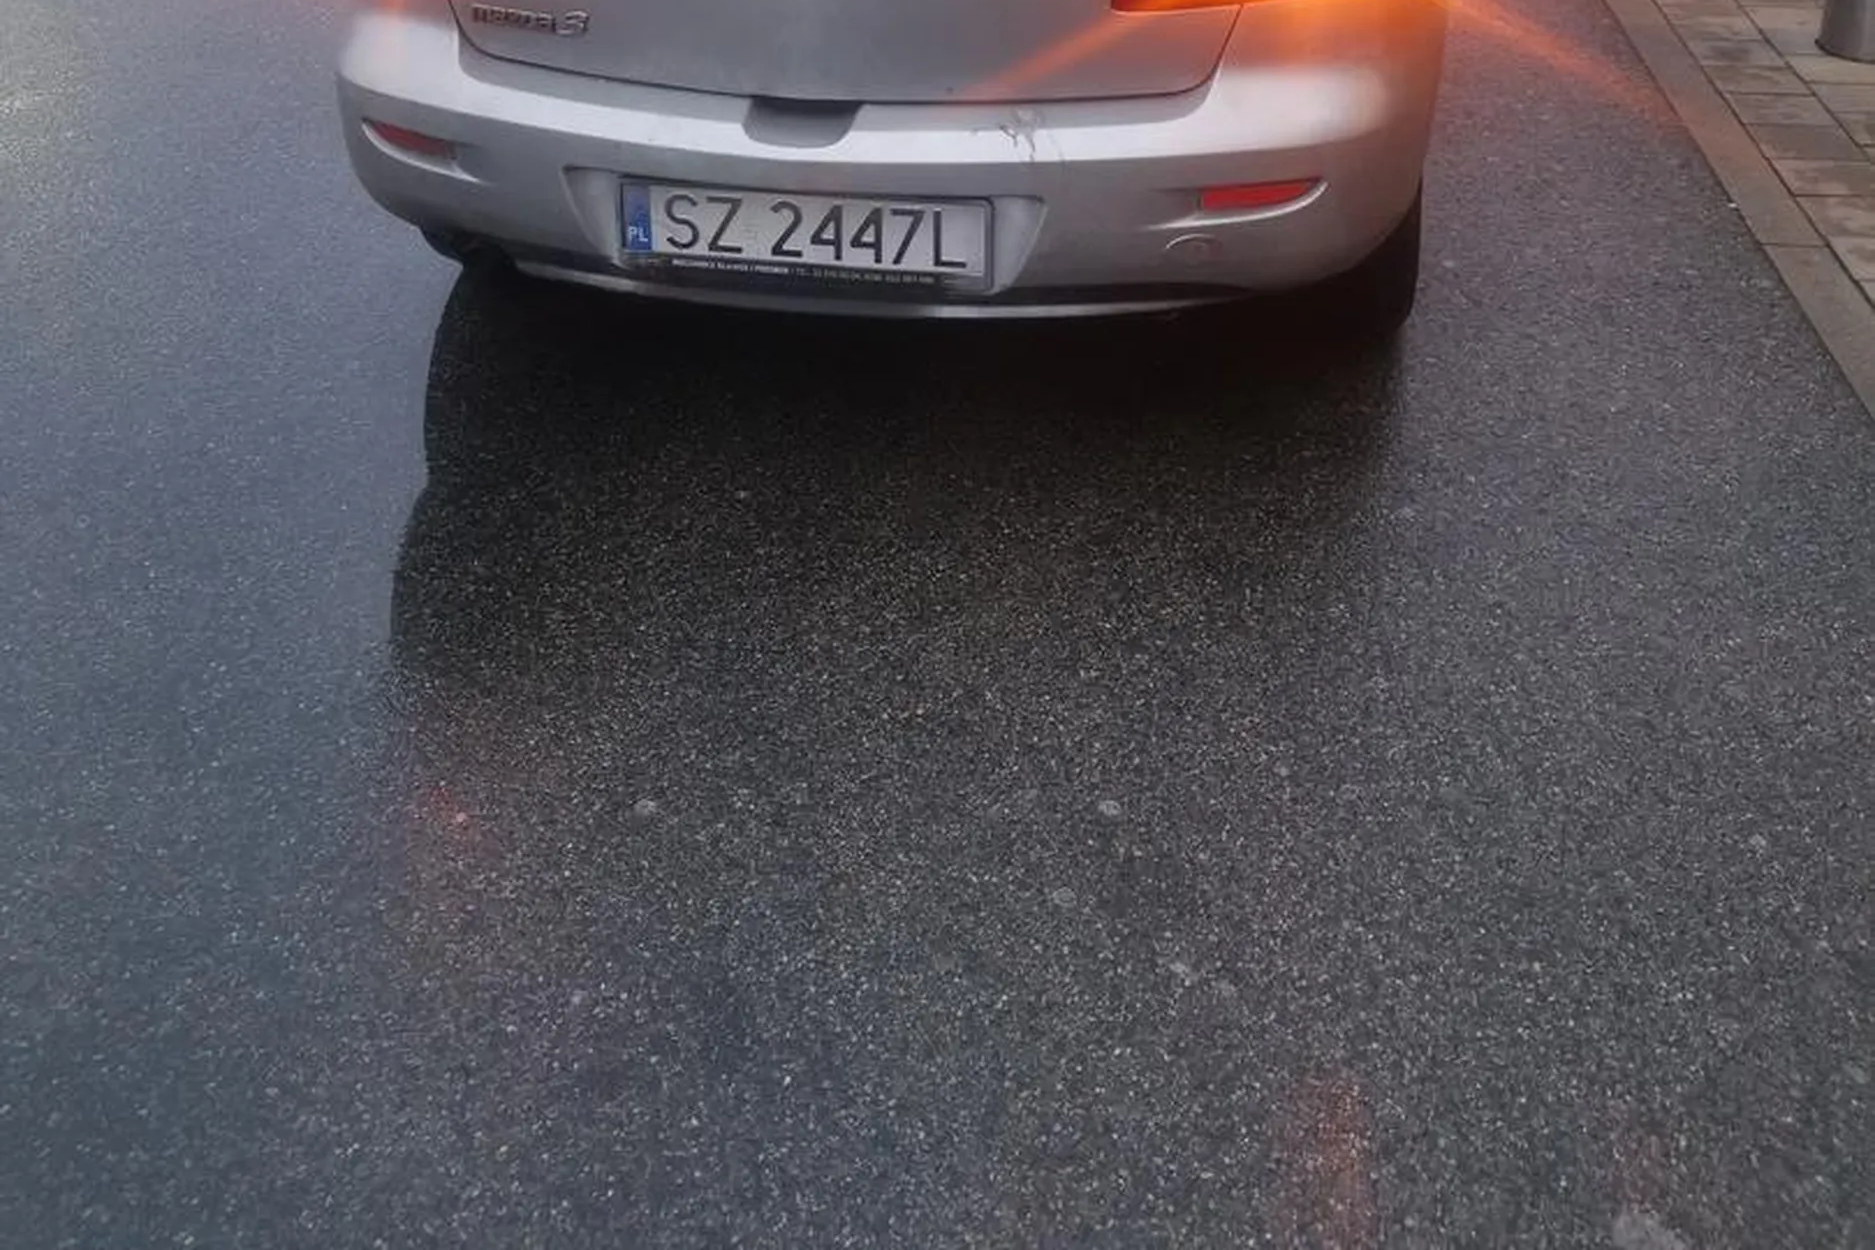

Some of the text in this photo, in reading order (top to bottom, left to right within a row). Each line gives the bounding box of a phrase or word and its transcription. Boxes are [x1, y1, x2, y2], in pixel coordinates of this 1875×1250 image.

[627, 225, 649, 243] PL
[664, 192, 968, 269] SZ 2447L
